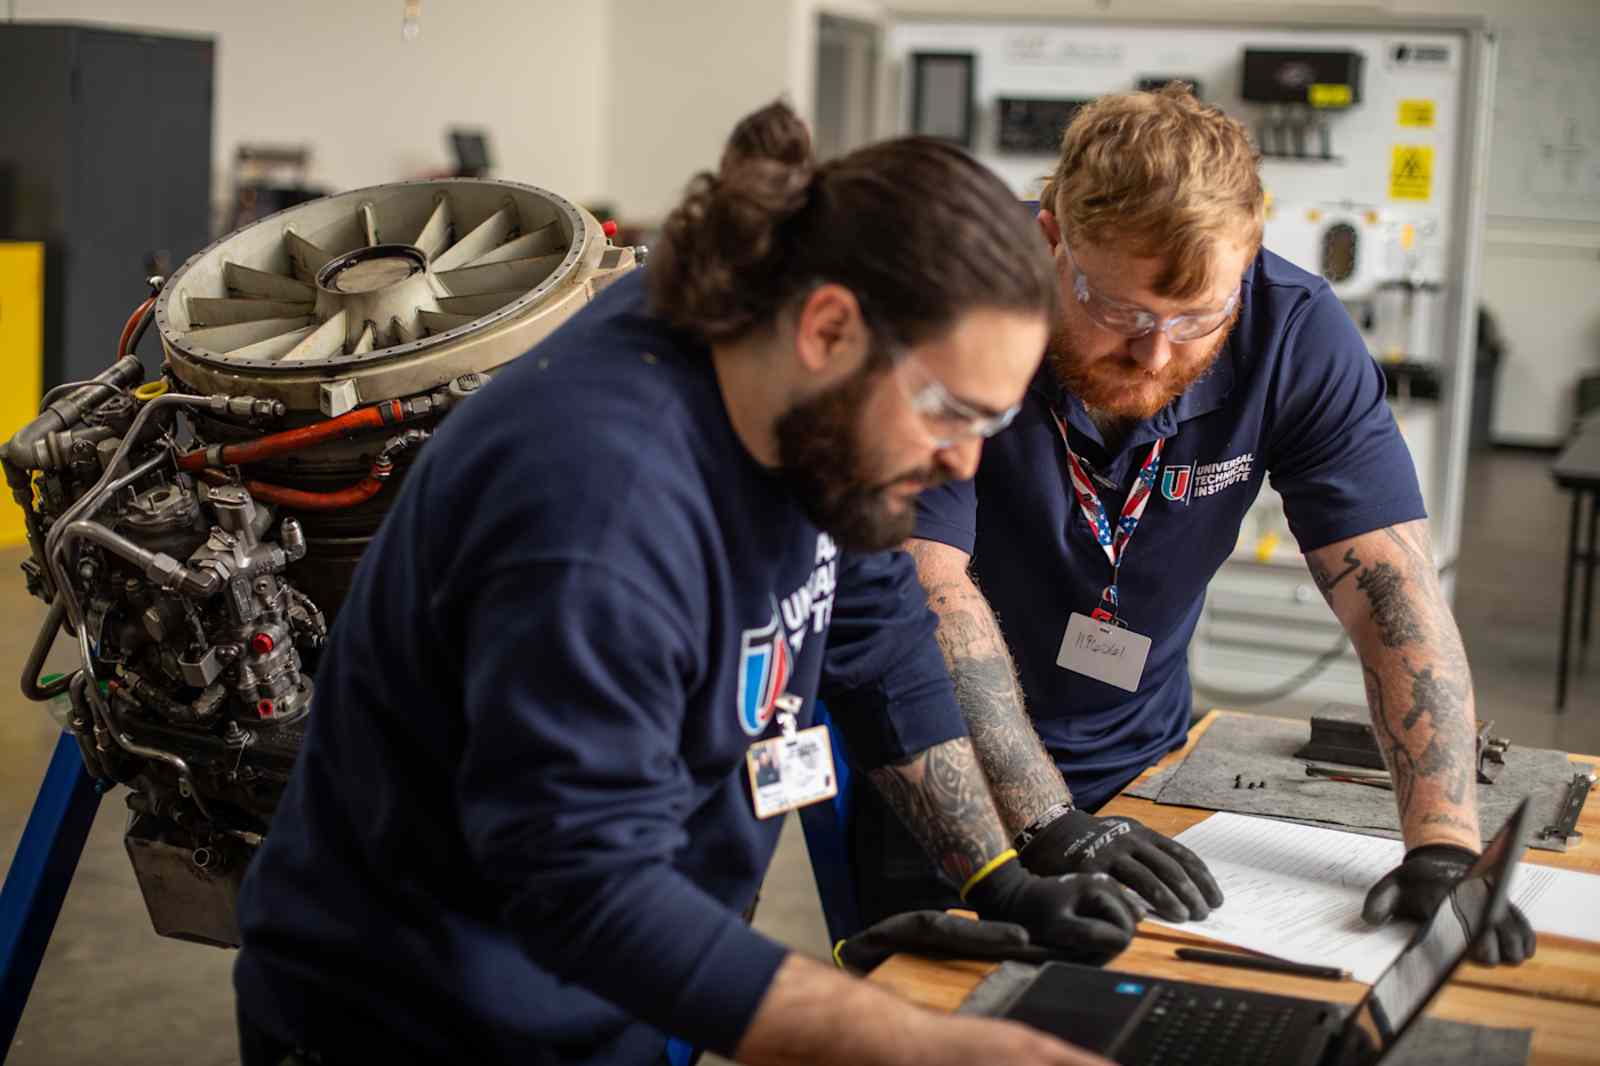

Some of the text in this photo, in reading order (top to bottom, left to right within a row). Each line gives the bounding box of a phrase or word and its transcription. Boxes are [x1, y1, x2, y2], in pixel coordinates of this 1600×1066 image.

[1195, 463, 1252, 485] TECHNICAL
[1196, 453, 1254, 475] UNIVERSAL
[1194, 472, 1250, 497] INSTITUTE
